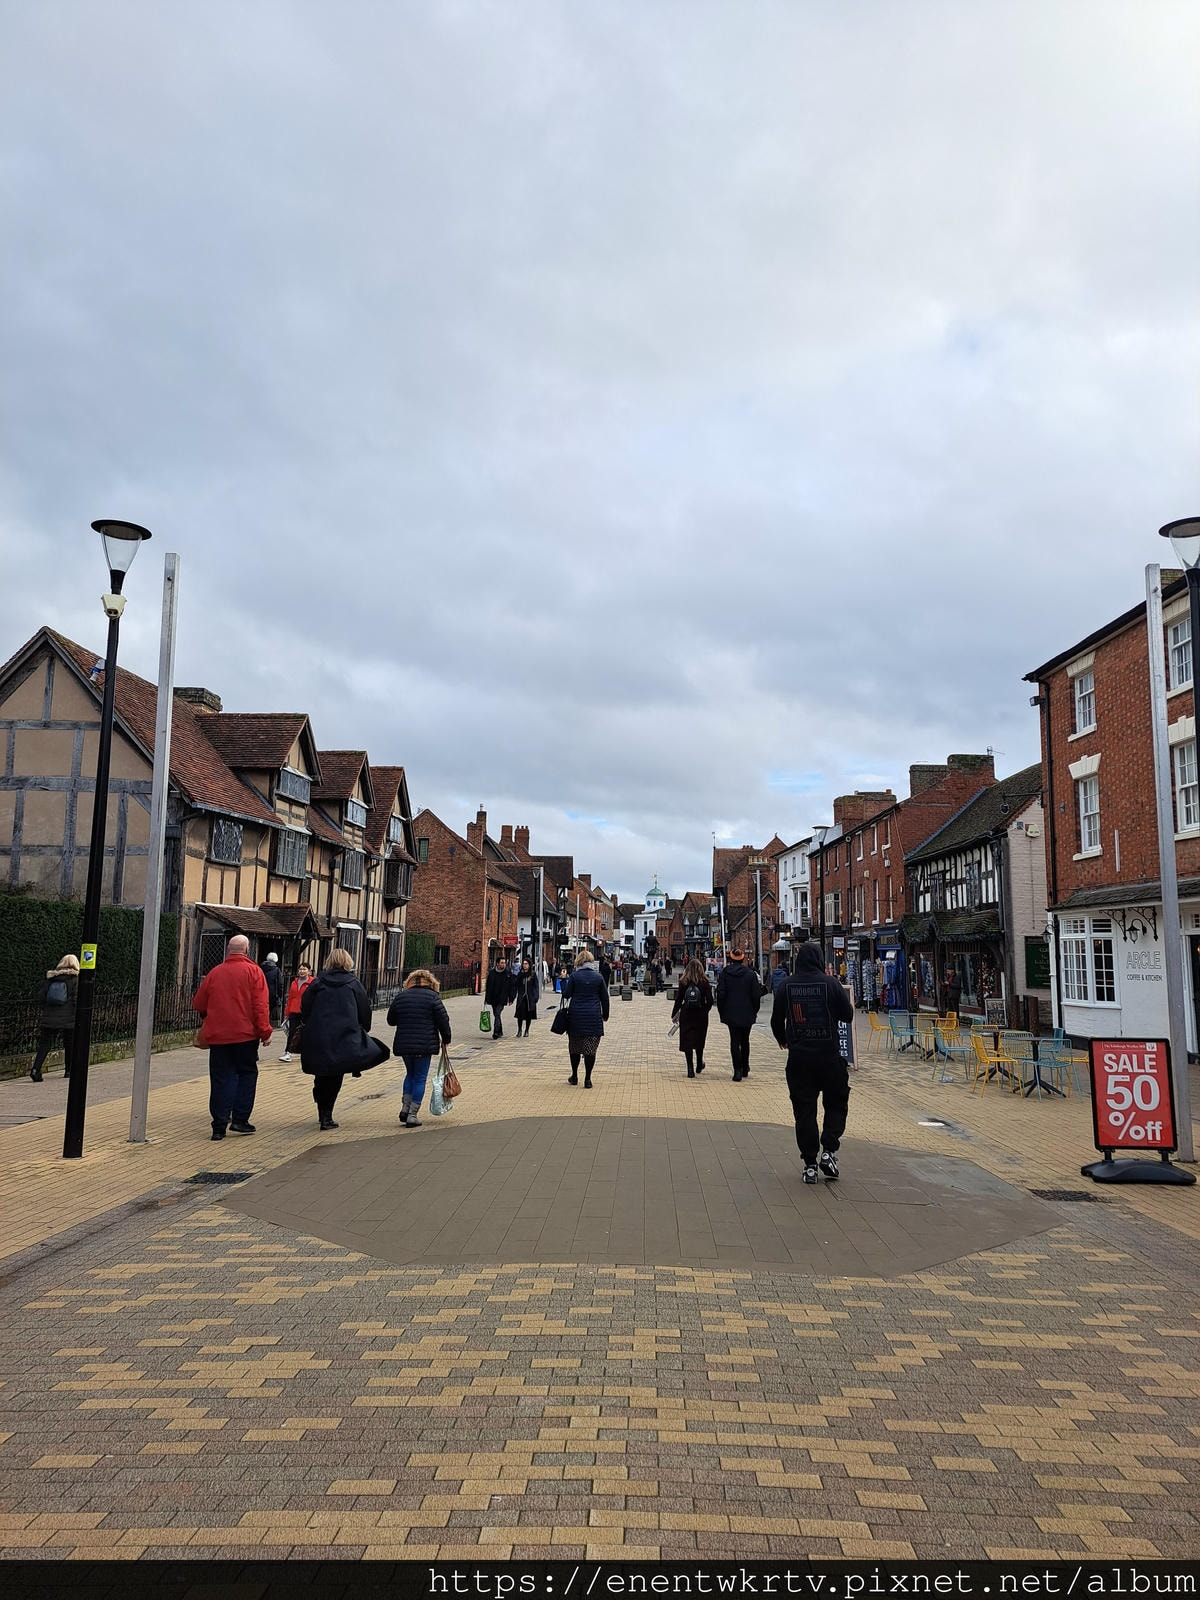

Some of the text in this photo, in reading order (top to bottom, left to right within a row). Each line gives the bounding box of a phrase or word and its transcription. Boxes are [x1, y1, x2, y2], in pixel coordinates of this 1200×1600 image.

[1145, 974, 1163, 982] KITCHEN
[1104, 1054, 1158, 1074] SALE
[1106, 1075, 1161, 1112] 50
[1108, 1111, 1163, 1141] %off
